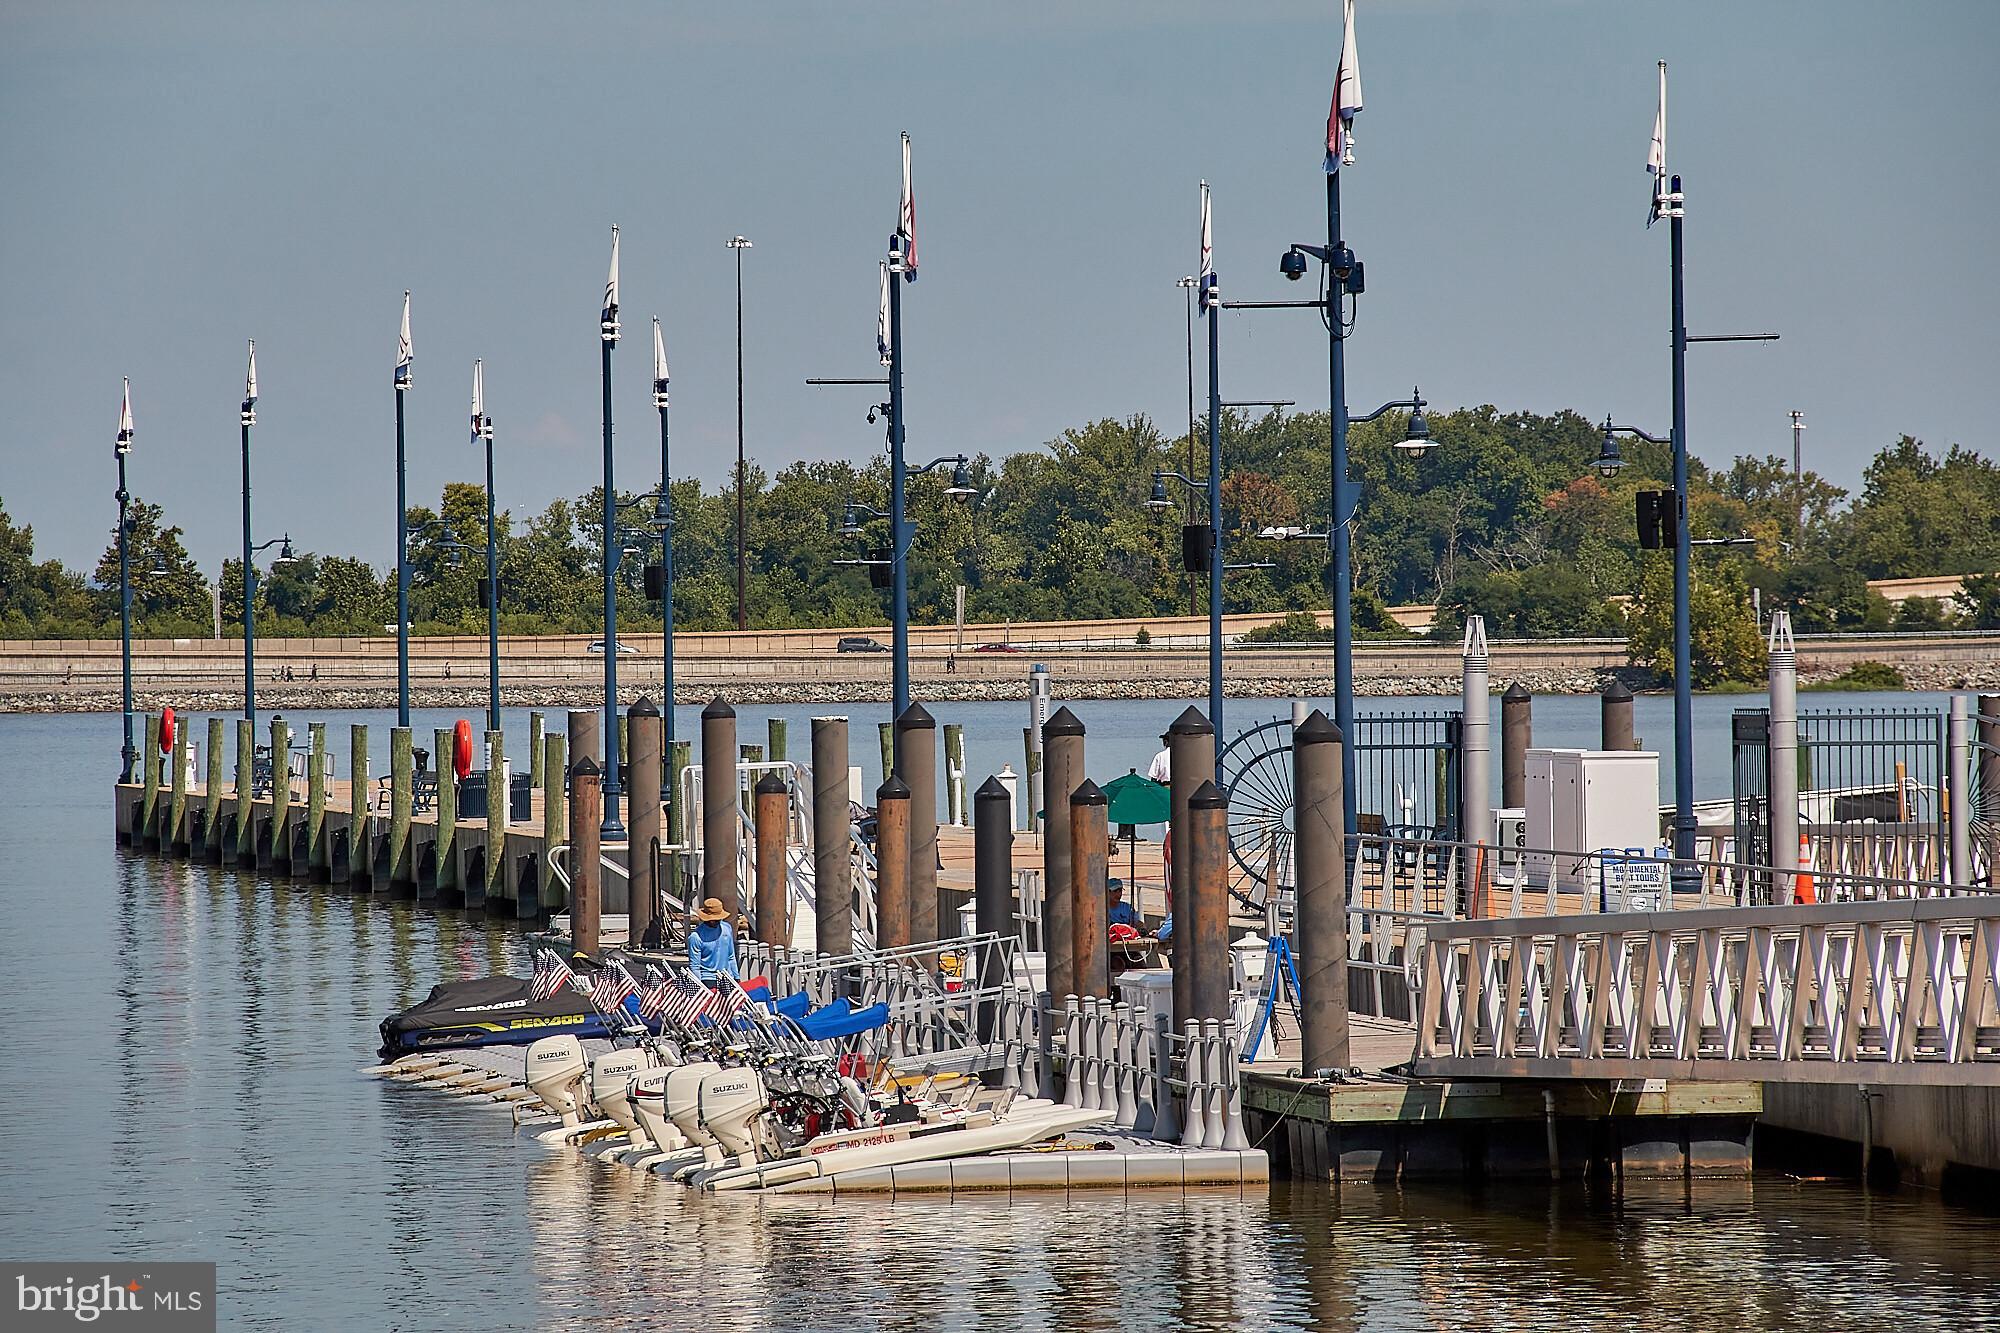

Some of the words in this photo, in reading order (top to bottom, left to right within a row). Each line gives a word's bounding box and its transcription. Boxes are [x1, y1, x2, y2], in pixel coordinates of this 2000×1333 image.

[1612, 865, 1661, 874] MOUMENTAL
[1636, 874, 1660, 882] TOURS
[537, 1050, 570, 1060] SUZUKI
[603, 1064, 638, 1075] SUZUKI
[644, 1076, 664, 1088] EVIN
[712, 1082, 748, 1094] SUZUKI
[847, 1139, 861, 1149] MD
[883, 1134, 895, 1144] LB
